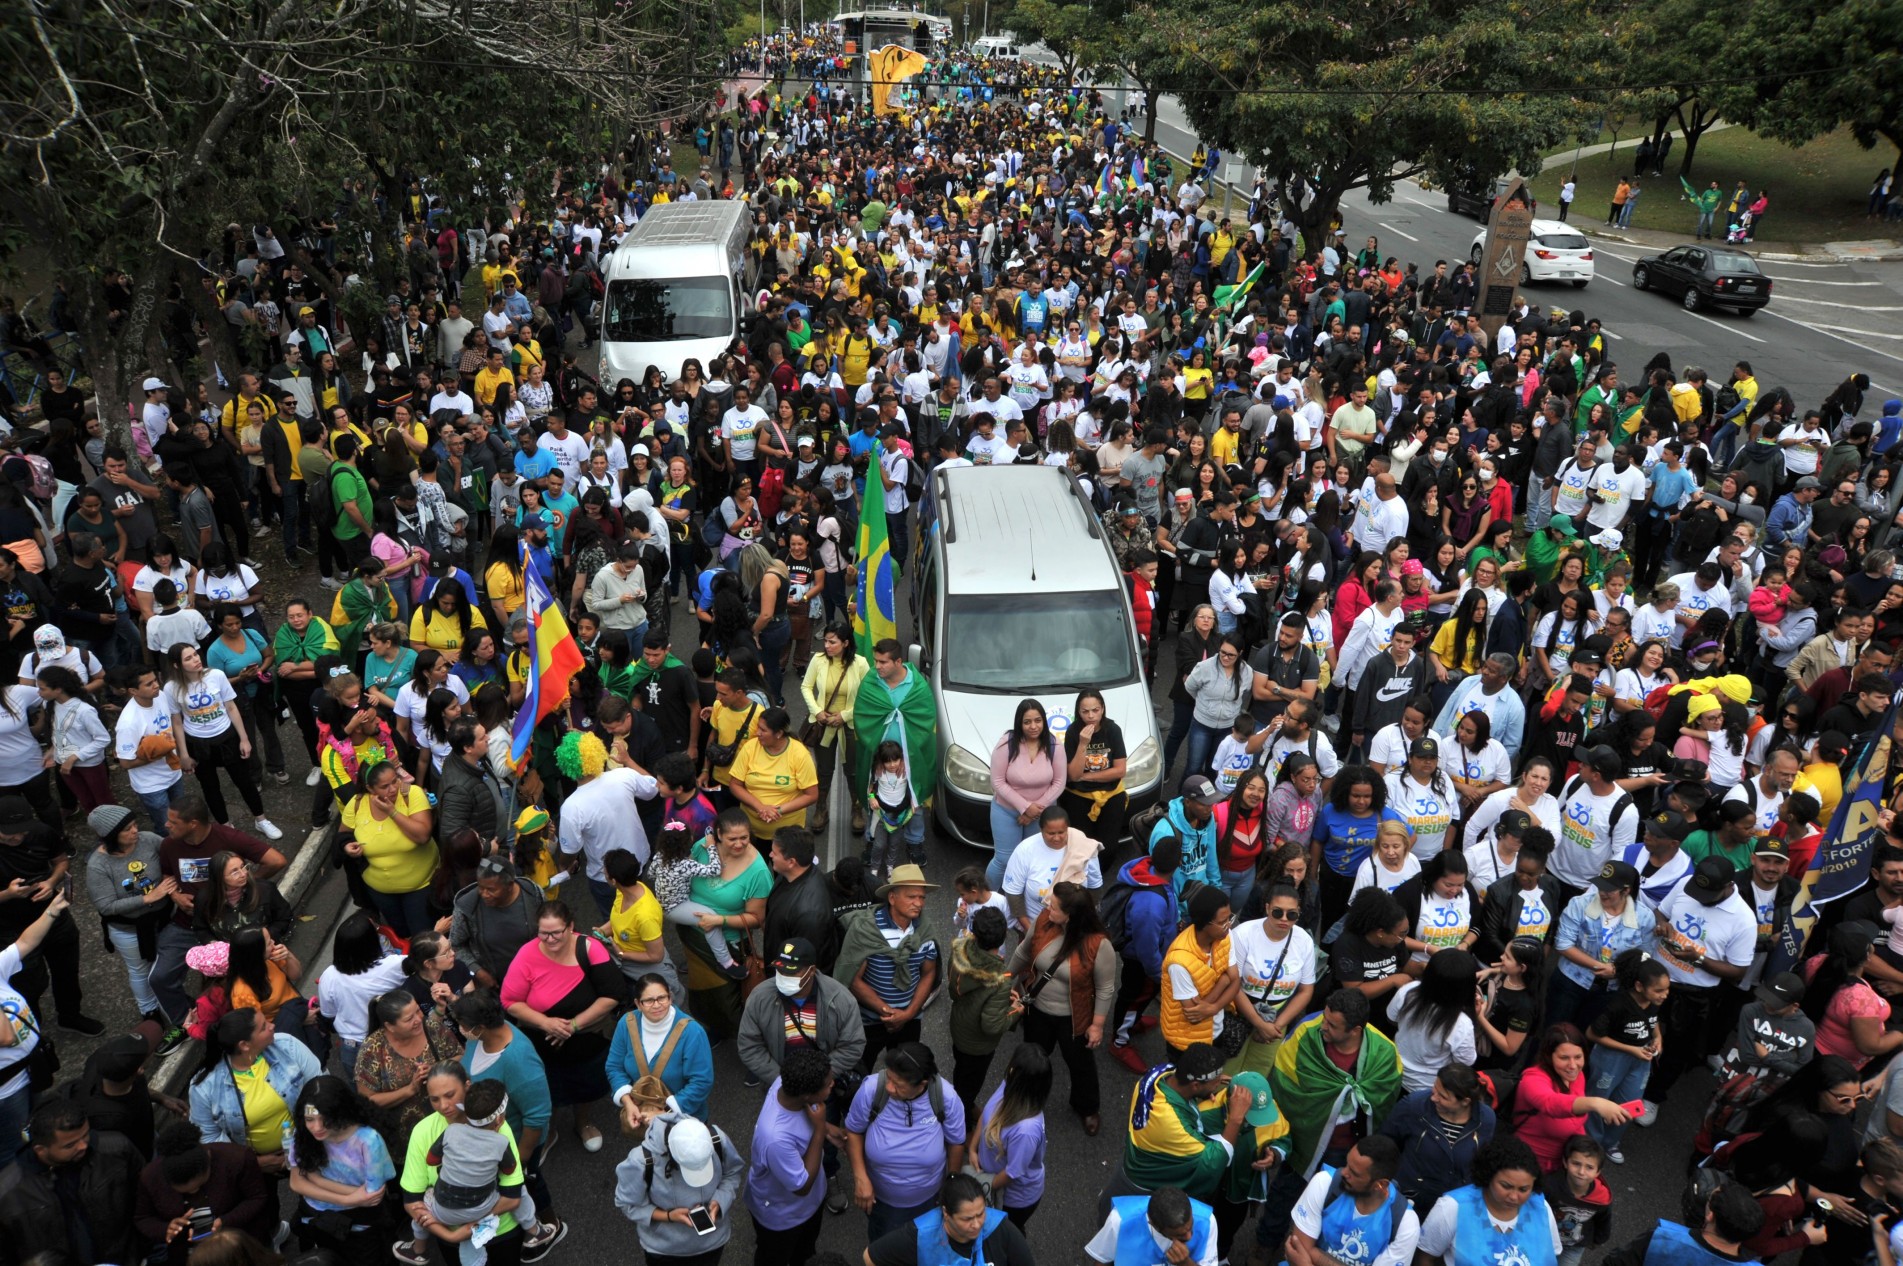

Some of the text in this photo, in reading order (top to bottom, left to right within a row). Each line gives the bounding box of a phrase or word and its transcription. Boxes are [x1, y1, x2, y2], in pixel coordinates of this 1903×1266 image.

[736, 419, 752, 429] 30
[1567, 476, 1582, 488] 30
[1602, 480, 1617, 491] 30
[1689, 595, 1708, 610] 30
[1656, 622, 1671, 636] 30
[1385, 677, 1414, 690] NIKE
[190, 693, 212, 709] 30
[190, 711, 225, 723] JESUS
[1085, 742, 1105, 750] UCCI
[1232, 754, 1250, 769] 30
[1415, 798, 1439, 815] 30
[1568, 802, 1591, 826] 30
[1408, 815, 1451, 825] MARCHA
[1411, 823, 1450, 835] JESUS
[1562, 824, 1594, 850] ESUS
[1433, 907, 1459, 927] 30
[1520, 905, 1545, 926] 30
[1676, 912, 1703, 941] 30
[1260, 960, 1284, 980] 30
